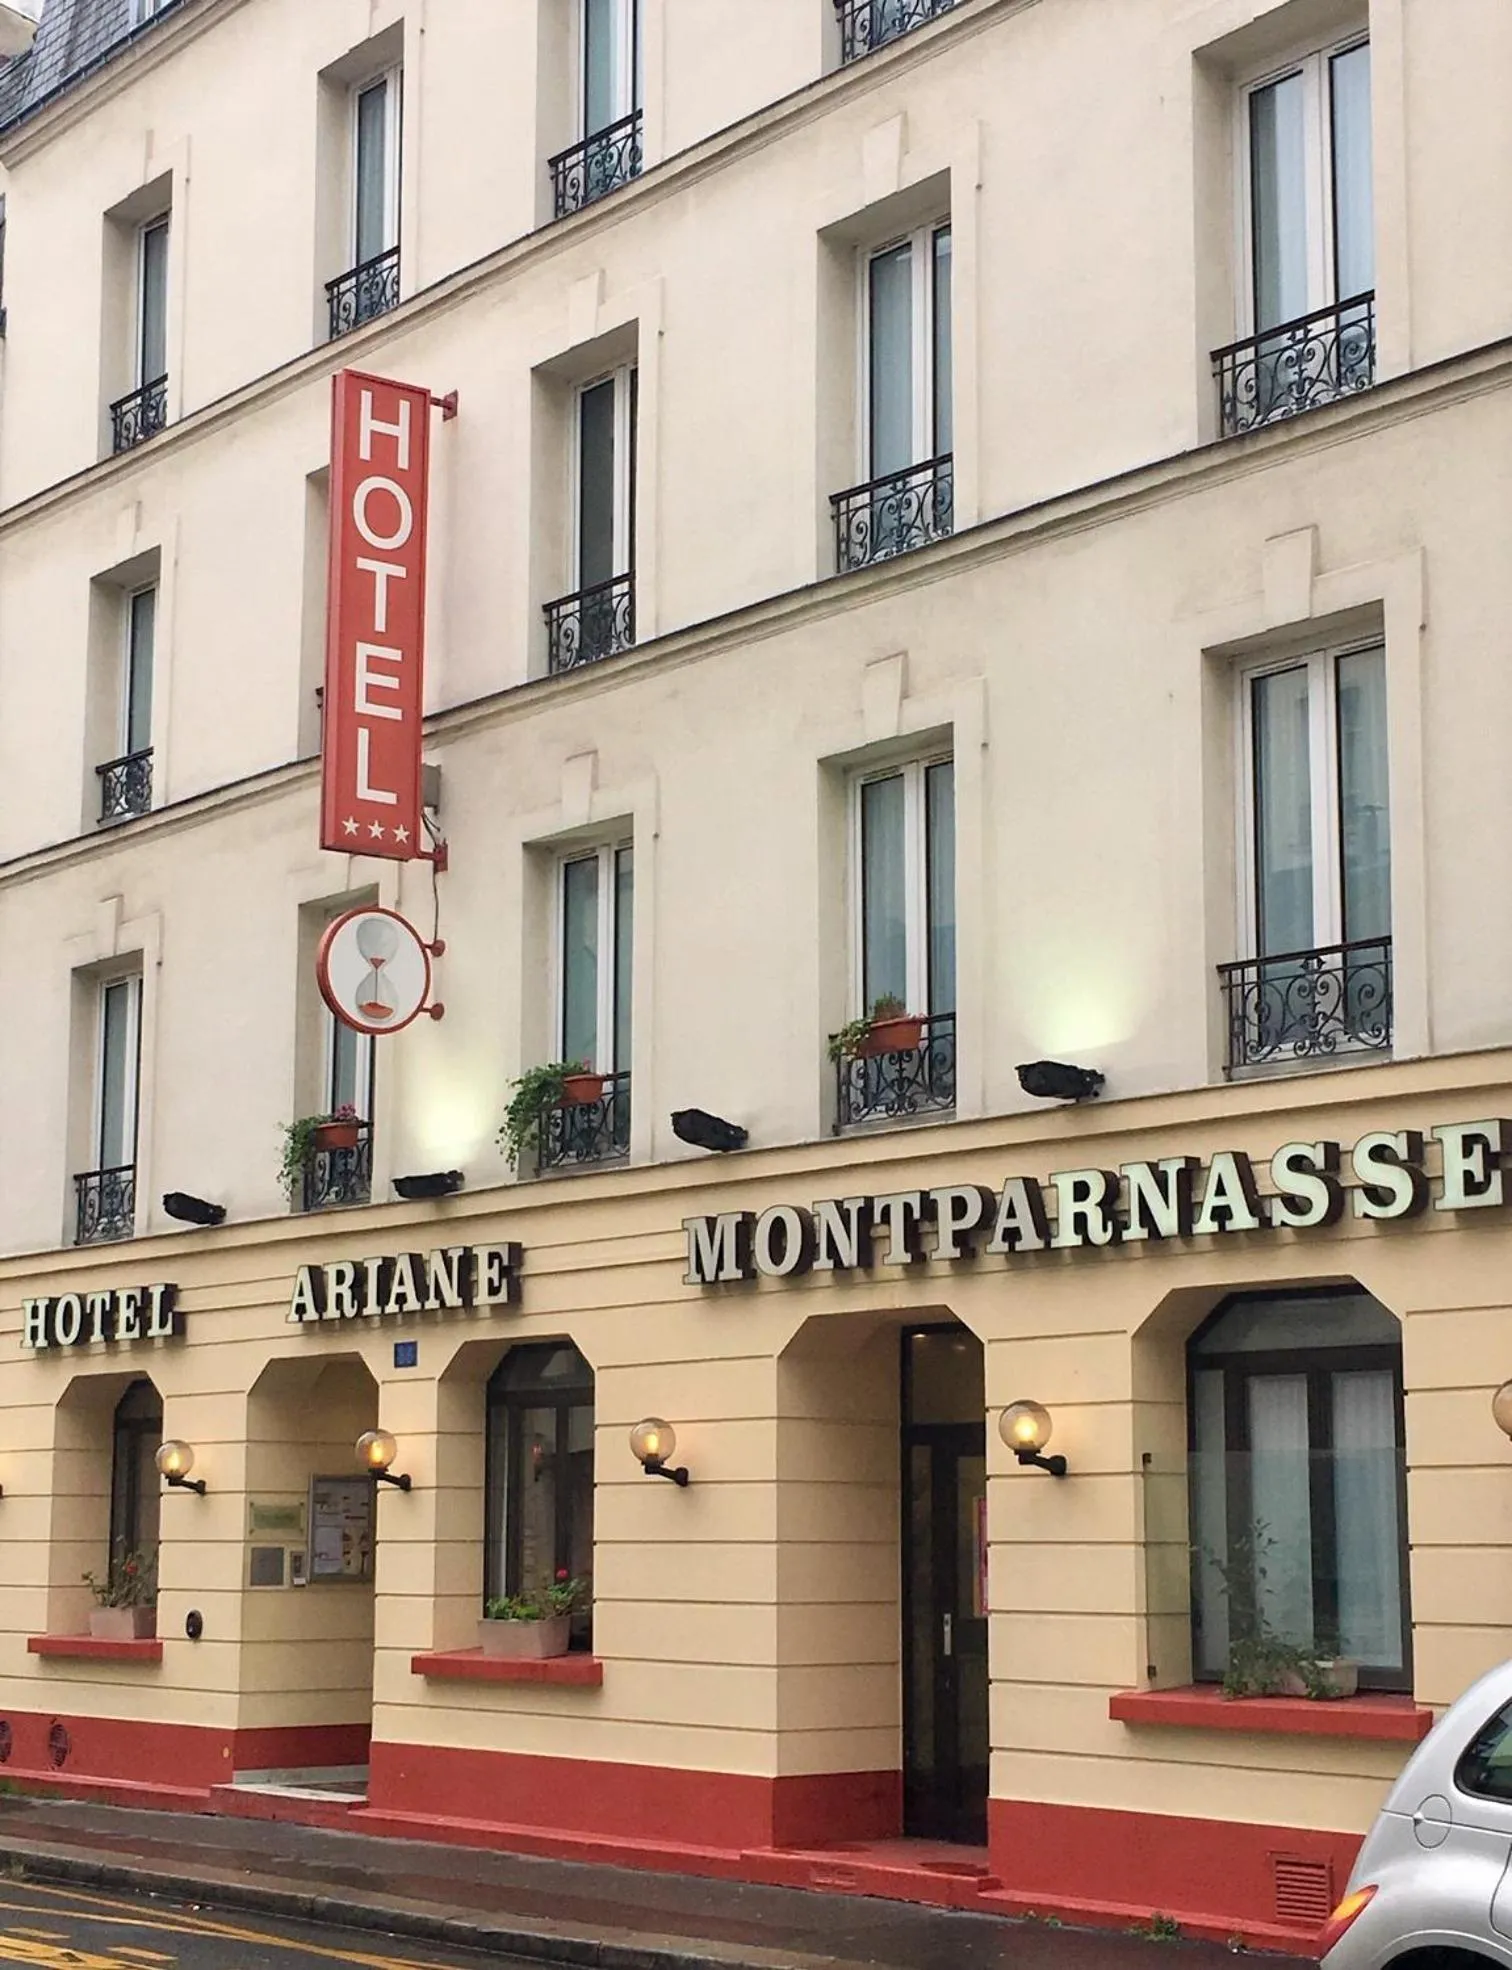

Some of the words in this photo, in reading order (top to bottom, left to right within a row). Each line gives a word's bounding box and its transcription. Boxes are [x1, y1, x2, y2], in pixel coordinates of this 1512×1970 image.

[353, 390, 413, 805] HOTEL
[20, 1283, 178, 1349] HOTEL
[285, 1242, 514, 1323] ARIANE
[682, 1118, 1506, 1285] MONTPARNASSE
